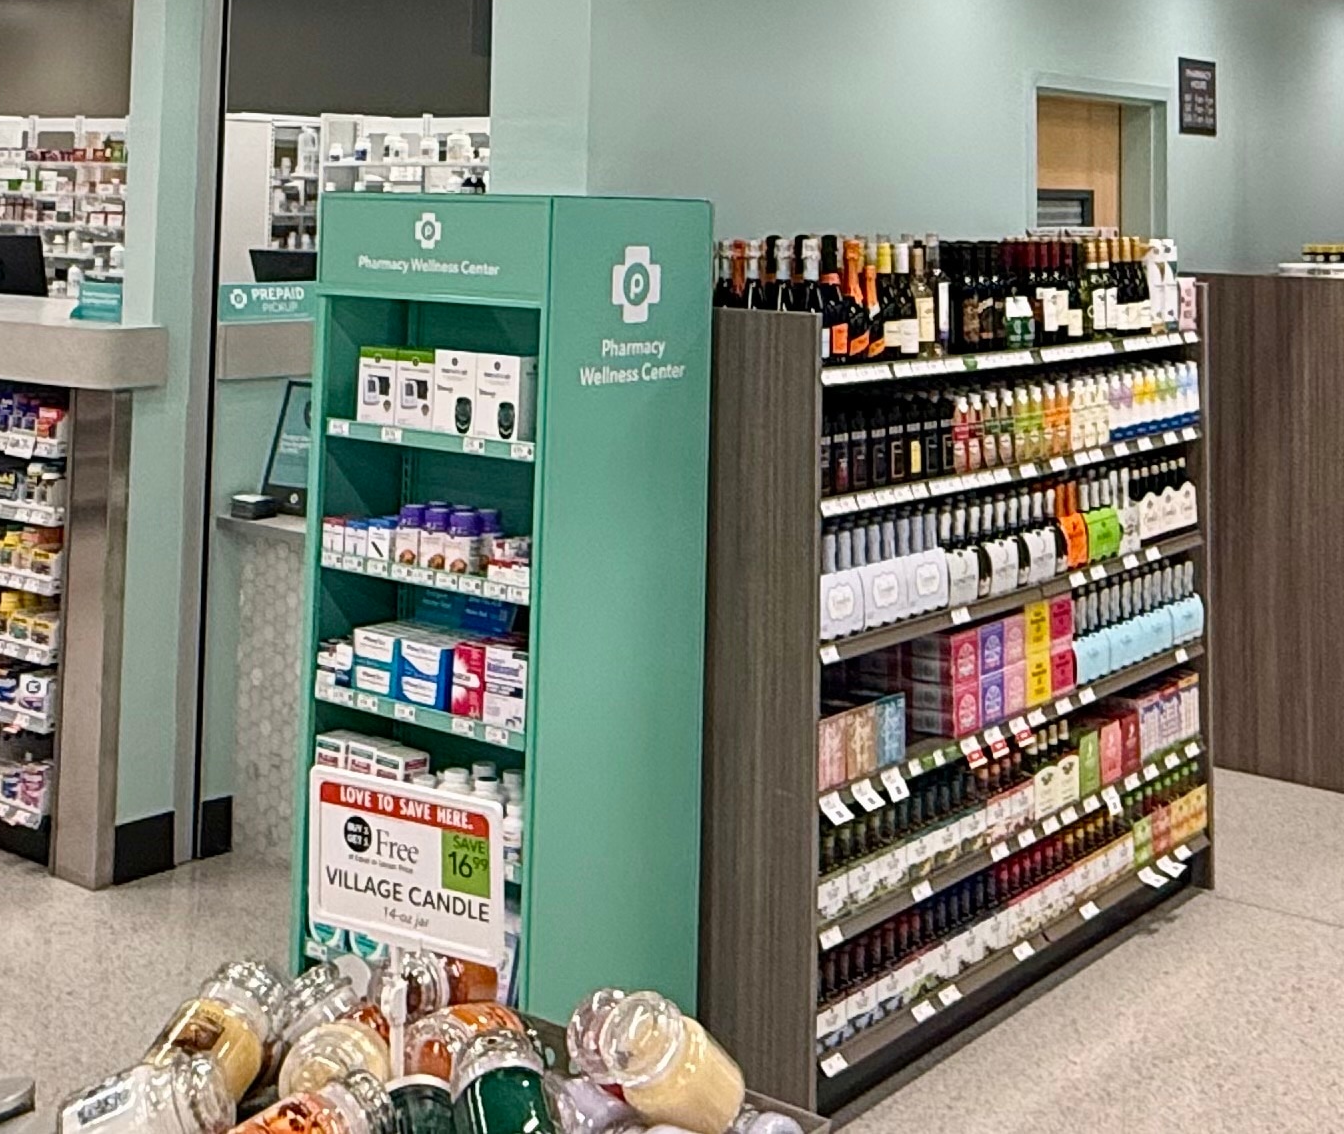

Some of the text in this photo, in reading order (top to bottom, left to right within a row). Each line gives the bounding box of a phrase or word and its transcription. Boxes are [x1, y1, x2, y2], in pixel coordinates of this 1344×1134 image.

[358, 254, 501, 277] Pharmacy Wellness Center
[251, 286, 304, 300] PREPAID
[601, 338, 666, 359] Pharmacy
[579, 360, 685, 386] Wellness Center
[340, 785, 474, 830] LOVE TO SAVE HERE.
[376, 828, 419, 864] Free
[453, 835, 486, 855] SAVE
[325, 866, 491, 923] VILLAGE CANDLE
